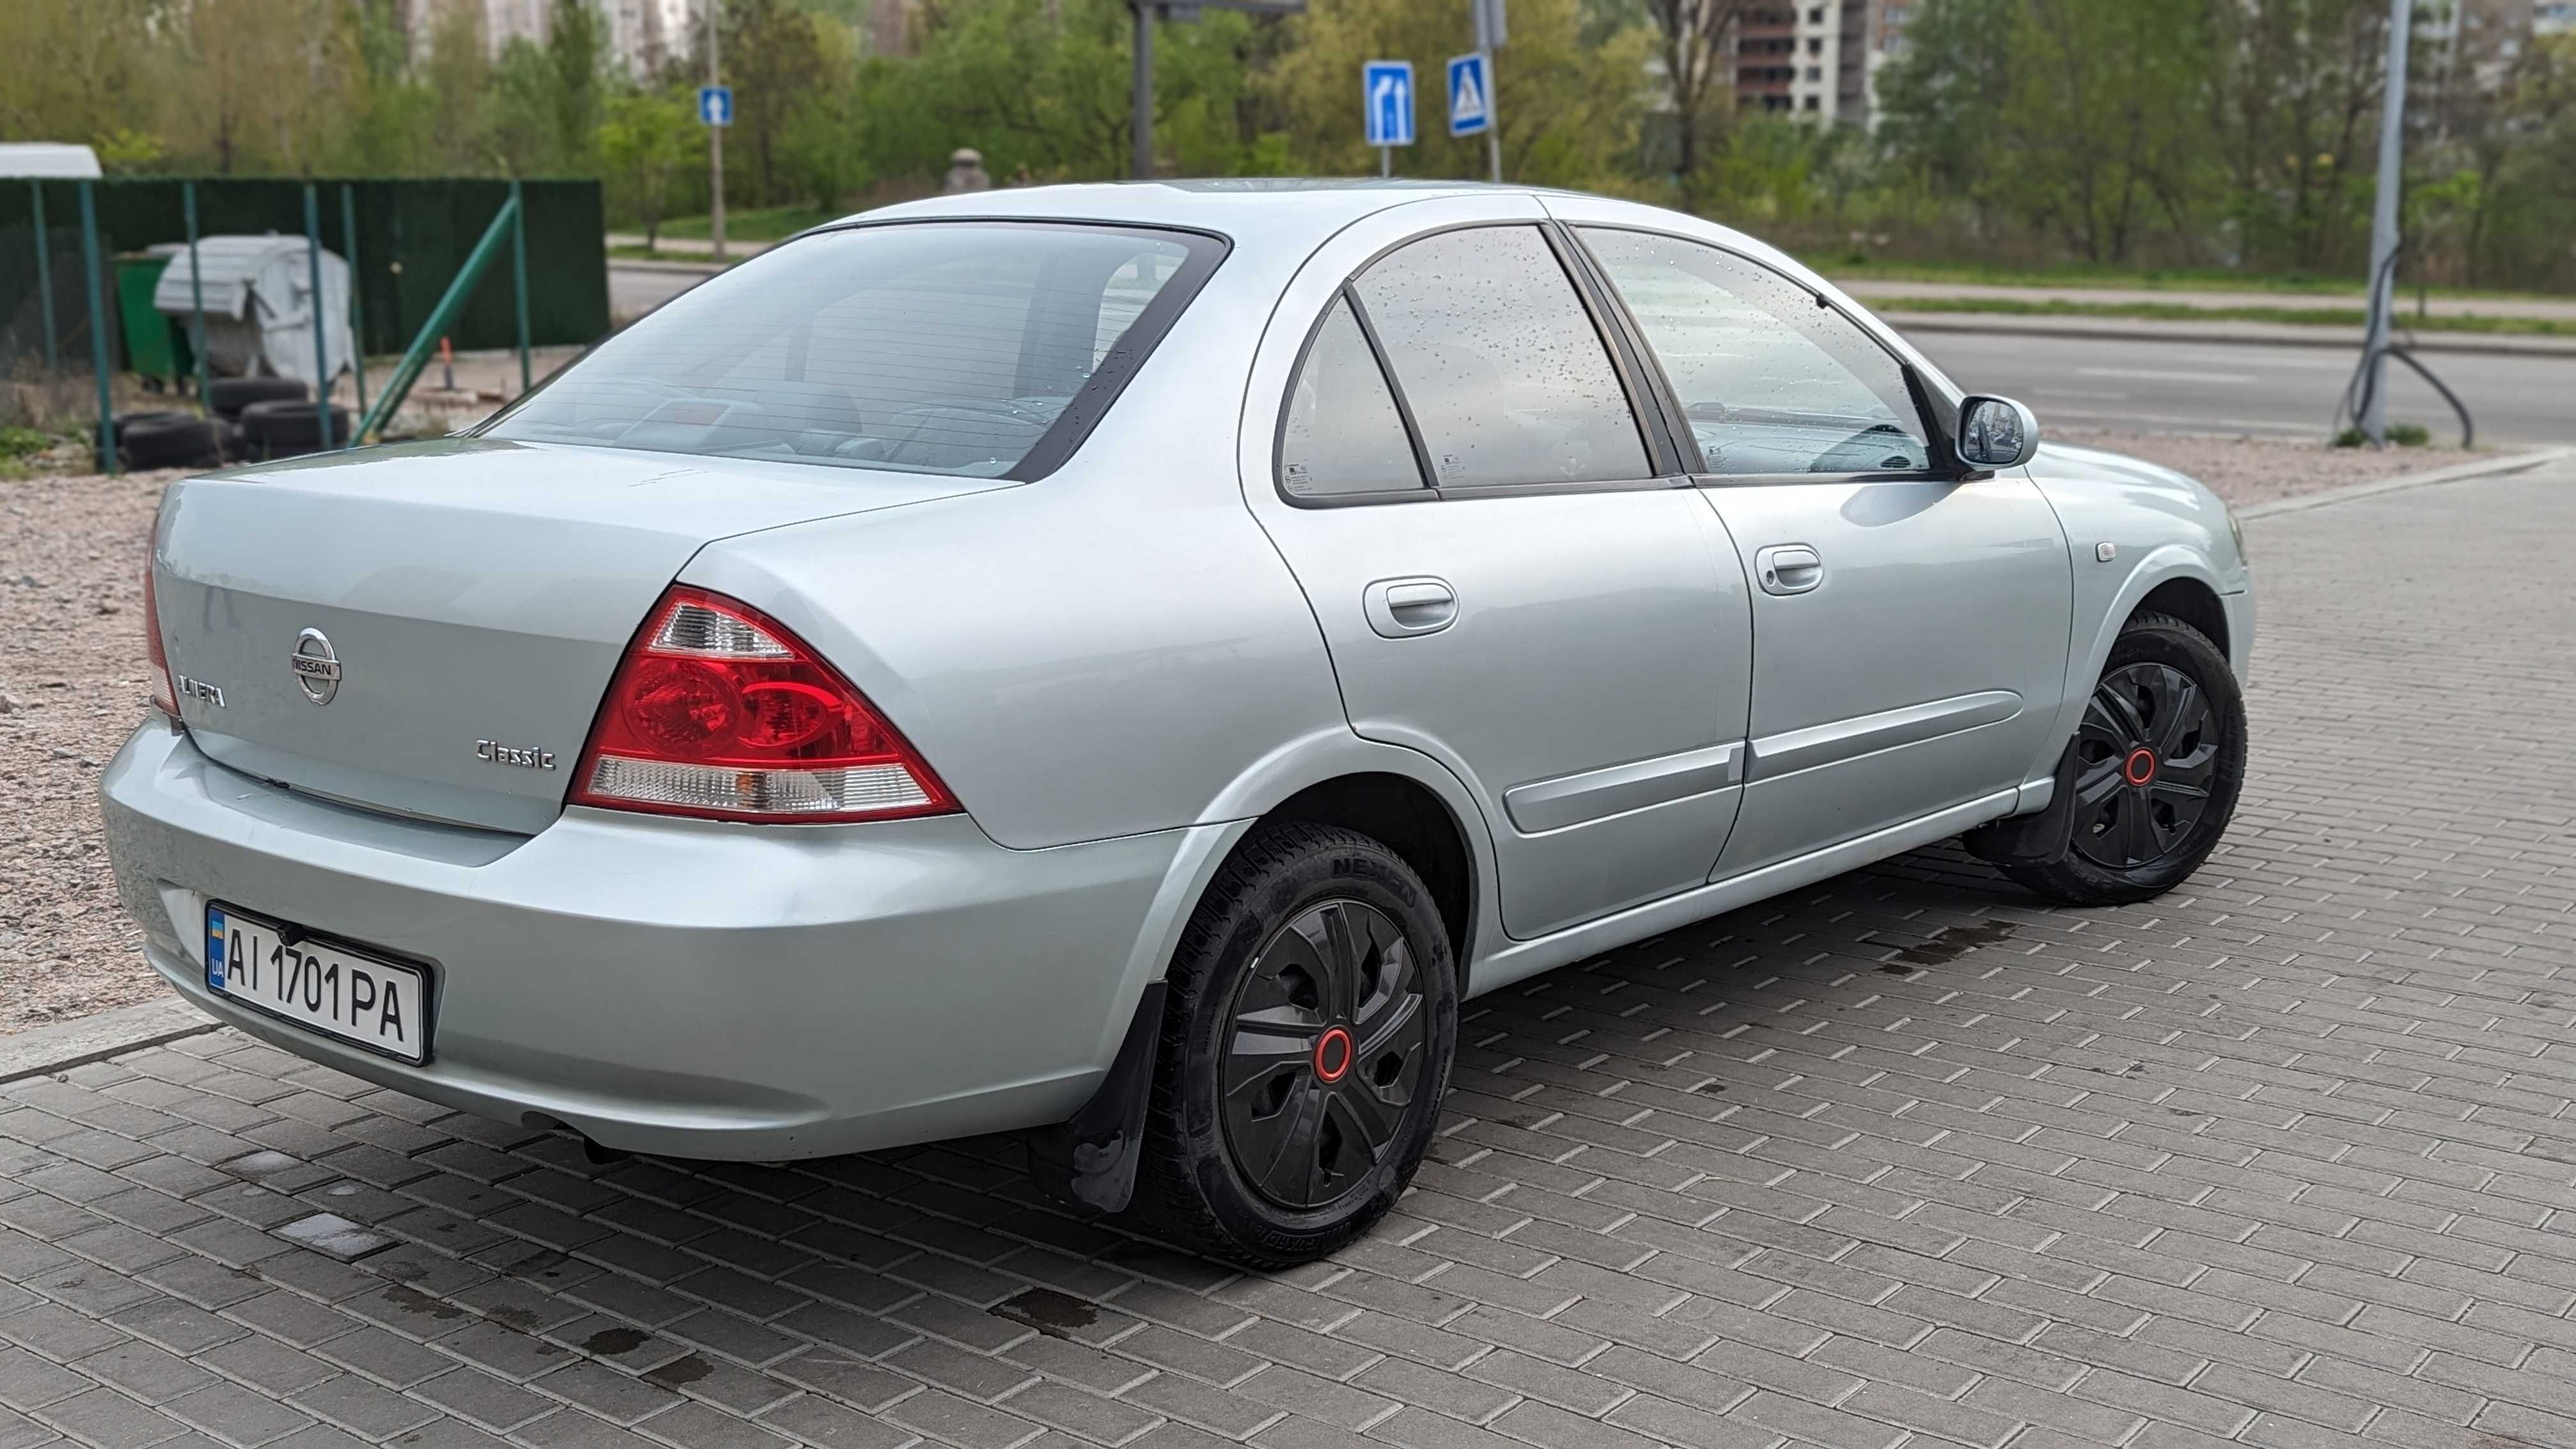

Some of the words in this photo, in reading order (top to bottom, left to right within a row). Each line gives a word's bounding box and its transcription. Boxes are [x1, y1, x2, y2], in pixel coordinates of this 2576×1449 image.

[292, 658, 332, 675] NISSAN
[475, 739, 556, 770] Classic
[211, 958, 224, 977] UA
[227, 928, 258, 991] AI
[270, 944, 341, 1021] 1701
[351, 969, 404, 1043] PA
